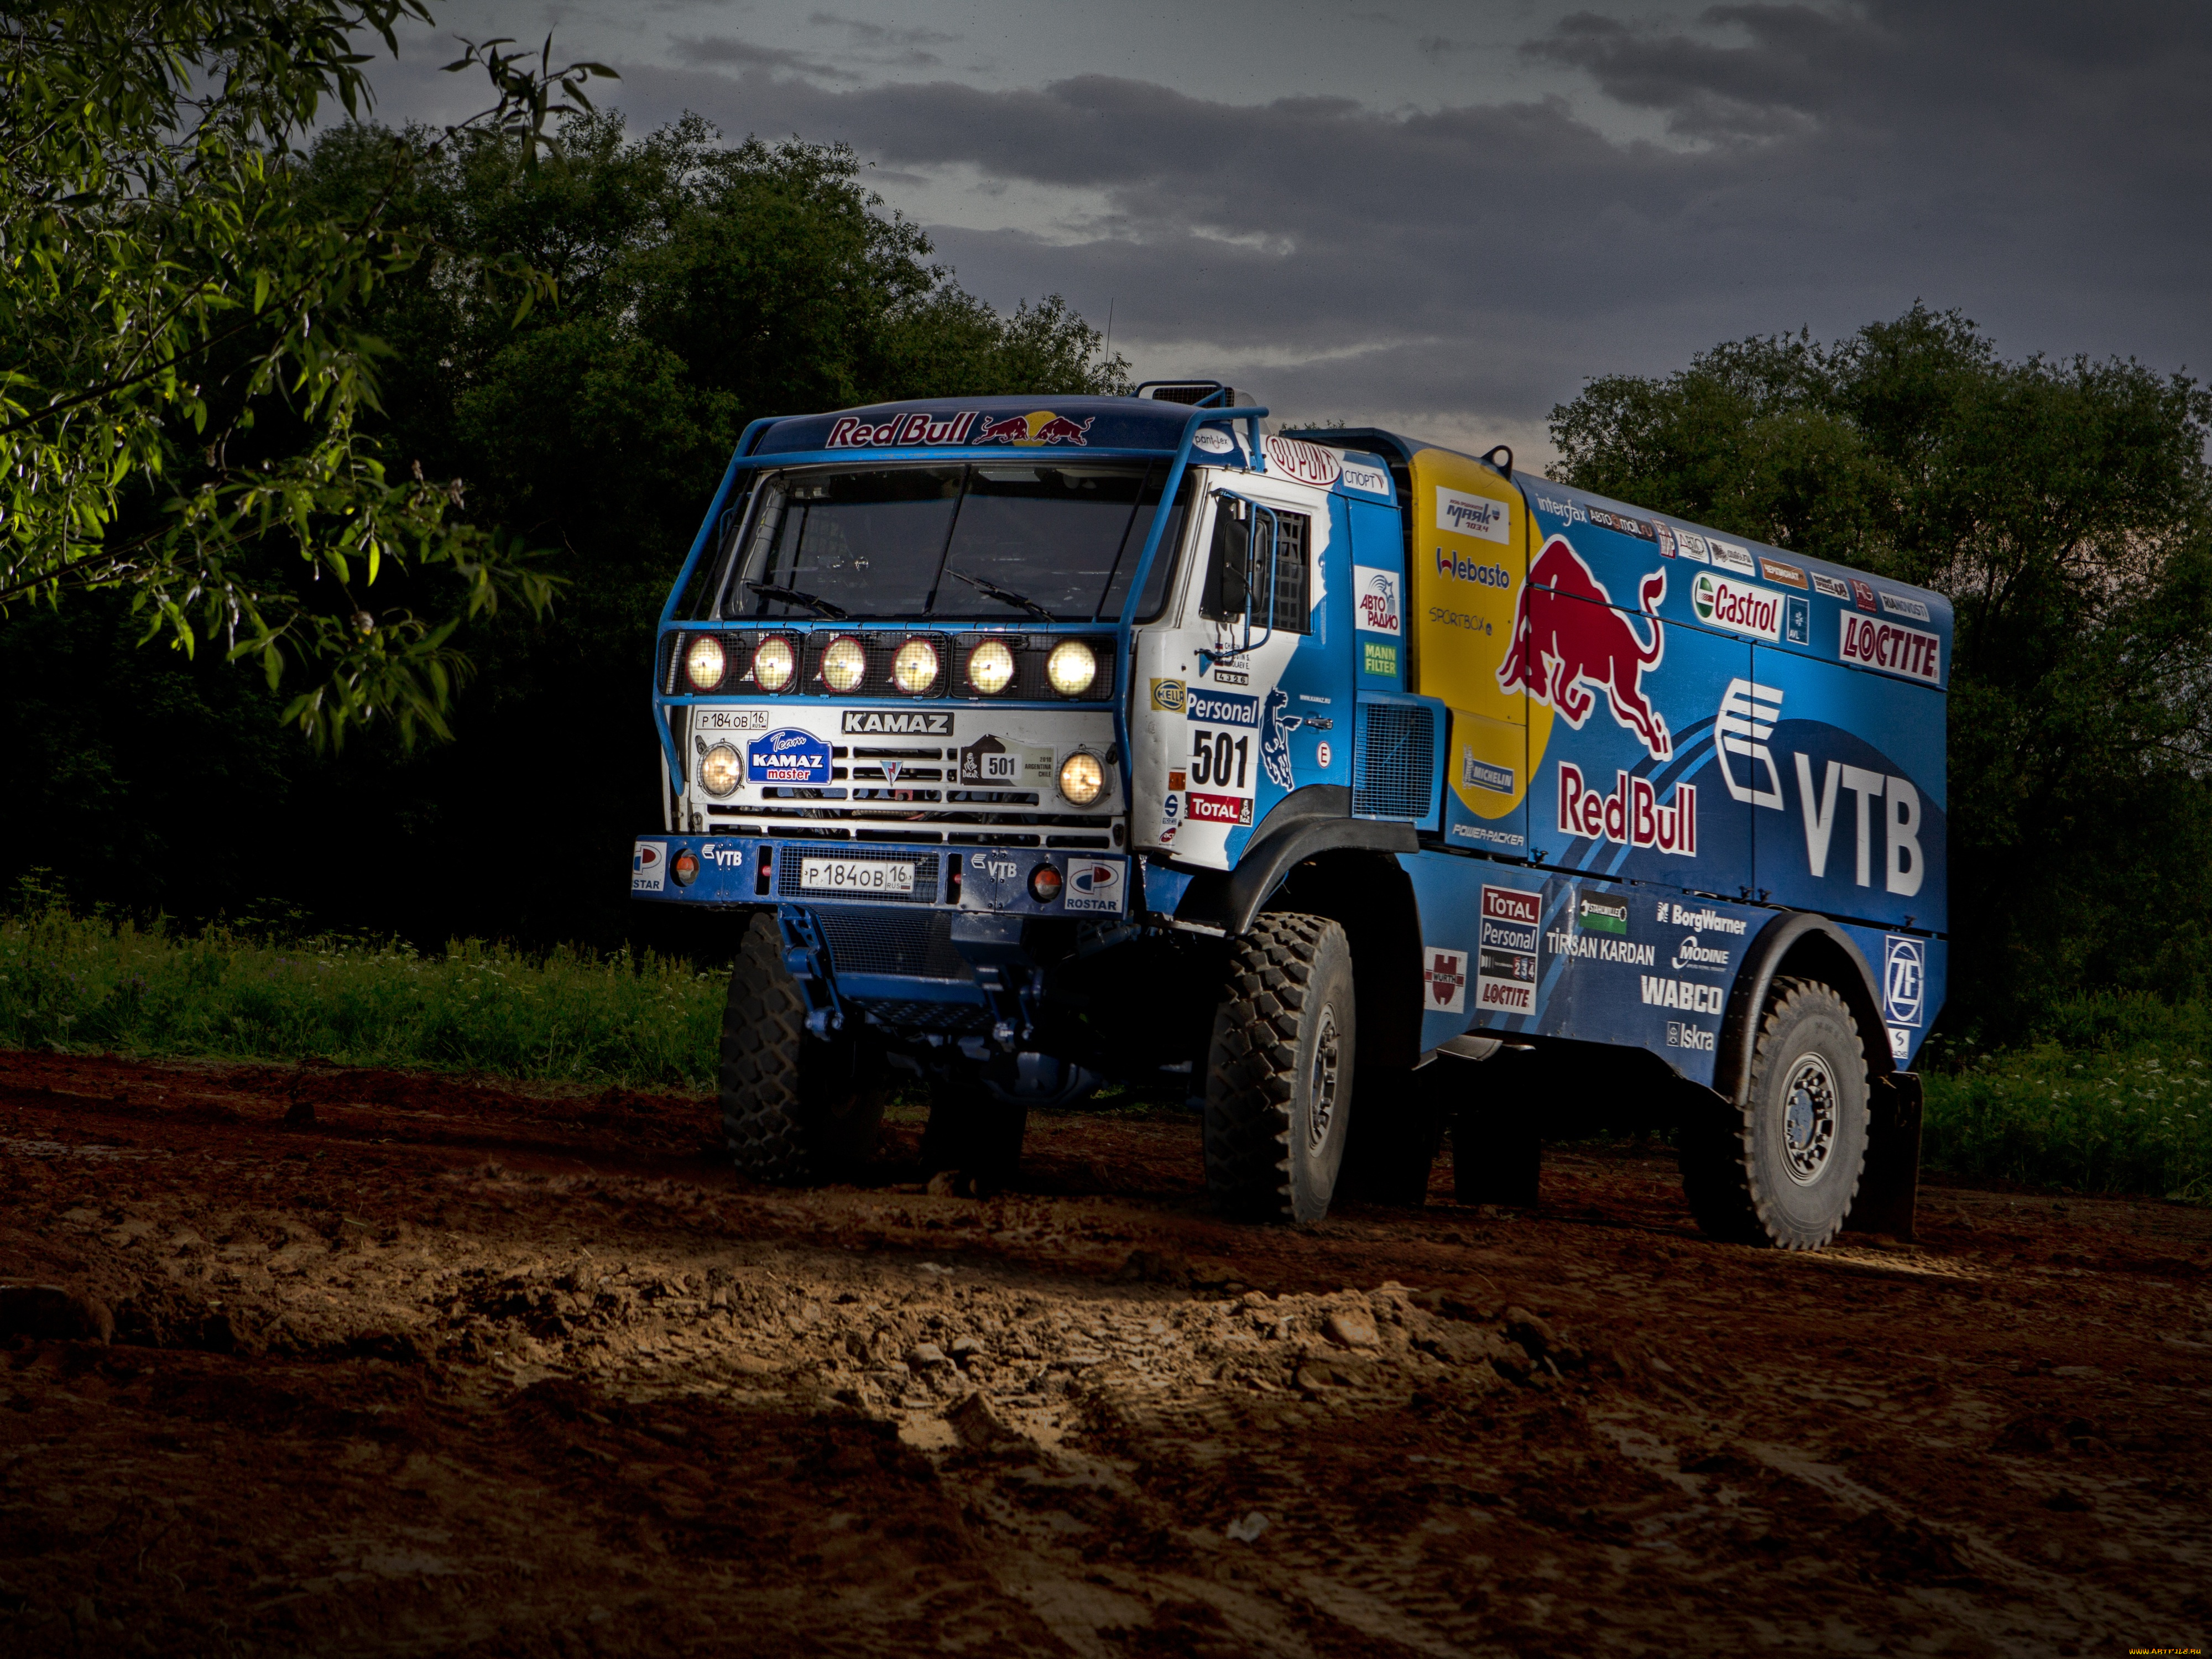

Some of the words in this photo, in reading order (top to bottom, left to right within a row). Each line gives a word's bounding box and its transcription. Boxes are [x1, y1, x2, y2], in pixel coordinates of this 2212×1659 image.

[825, 413, 907, 448] Red
[898, 411, 979, 445] Bull
[1345, 470, 1375, 488] СПОРТ
[1536, 493, 1588, 526] interfax
[1466, 522, 1489, 533] 103,4
[1436, 546, 1510, 589] Webasto
[1360, 594, 1386, 613] АВТО
[1715, 584, 1777, 634] Castrol
[1368, 611, 1399, 630] РАДИО
[1365, 644, 1396, 661] MANN
[1843, 617, 1938, 677] LOCTITE
[1365, 659, 1396, 675] FILTER
[1157, 690, 1184, 703] HELLA
[753, 712, 764, 723] 16
[1187, 693, 1255, 724] Personal
[845, 713, 949, 734] KAMAZ
[771, 732, 807, 752] Team
[753, 754, 825, 768] KAMAZ
[1192, 729, 1248, 789] 501
[1321, 747, 1327, 763] E
[767, 768, 811, 780] master
[989, 757, 1015, 775] 501
[1473, 766, 1512, 787] MICHELIN
[1193, 798, 1238, 819] TOTAL
[1558, 761, 1629, 844] Red
[1631, 776, 1697, 858] Bull
[1794, 752, 1924, 897] VTB
[716, 851, 742, 867] VTB
[988, 861, 1017, 878] VTB
[633, 879, 660, 889] STAR
[890, 866, 907, 882] 16
[1067, 899, 1117, 911] ROSTAR
[1487, 892, 1535, 920] TOTAL
[1672, 904, 1747, 935] BorgWarner
[1483, 922, 1536, 950] Personal
[1600, 940, 1655, 967] KARDAN
[1679, 946, 1730, 964] MODINE
[1890, 957, 1921, 1005] ZF
[1482, 983, 1530, 1008] LOCTITE
[1640, 975, 1724, 1015] WABCO
[1679, 1022, 1714, 1051] Iskra
